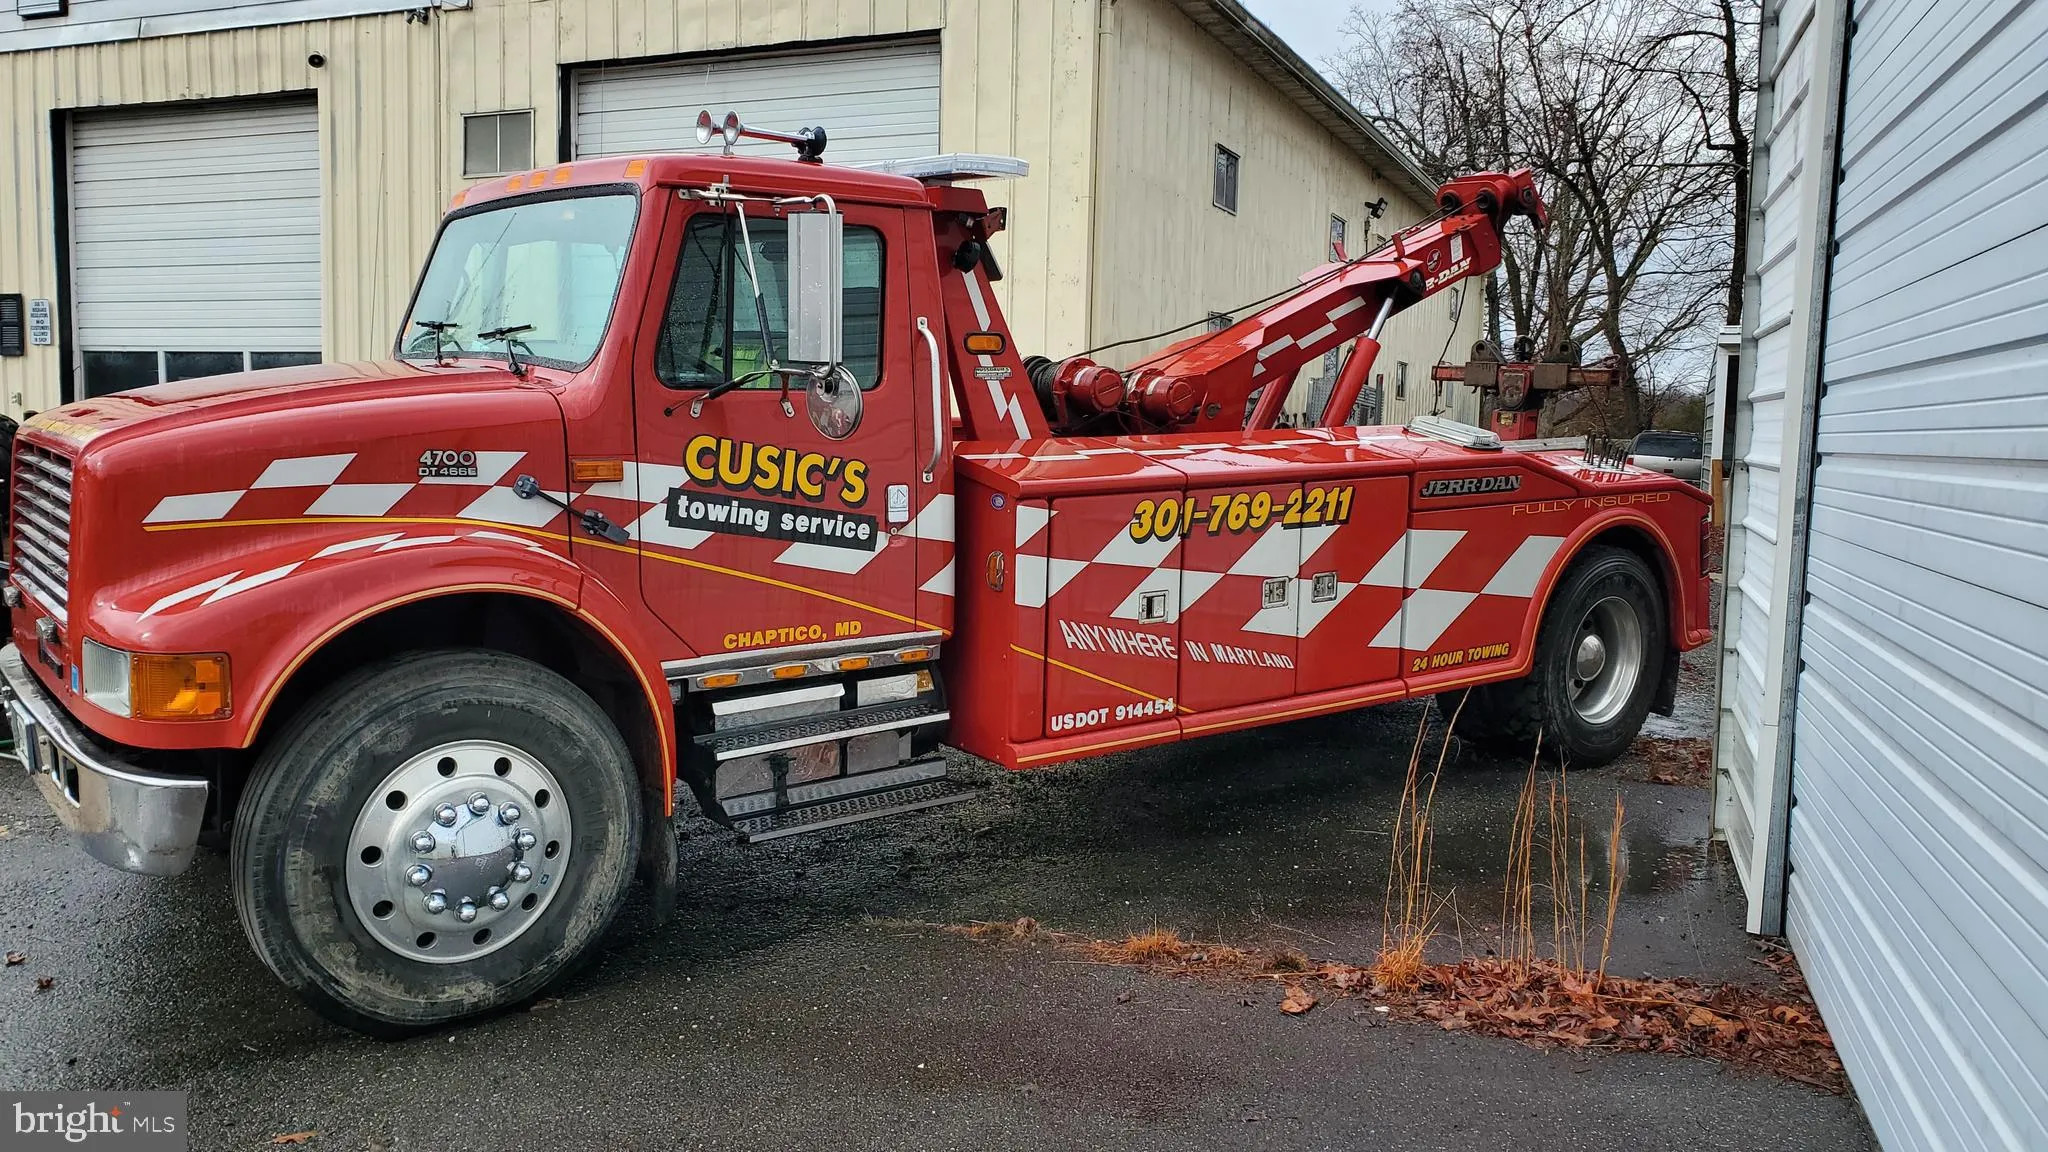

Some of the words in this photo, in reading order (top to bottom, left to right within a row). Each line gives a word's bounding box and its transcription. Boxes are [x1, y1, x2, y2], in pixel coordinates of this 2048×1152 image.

[1425, 257, 1472, 291] R-DAN
[418, 467, 437, 476] DT
[439, 467, 477, 476] 466E
[419, 449, 475, 466] 4700
[684, 434, 868, 506] CUSIC'S
[677, 494, 770, 532] towing
[780, 511, 871, 541] service
[1130, 486, 1355, 543] 301-769-2211
[1512, 499, 1577, 516] FULLY
[1583, 491, 1672, 509] INSURED
[723, 624, 828, 650] CHAPTICO,
[834, 620, 863, 637] MD
[1058, 619, 1178, 660] ANYWHERE
[1184, 640, 1210, 664] IN
[1209, 642, 1295, 670] MARYLAND
[1411, 656, 1429, 672] 24
[1431, 650, 1464, 668] HOUR
[1467, 642, 1511, 662] TOWING
[1051, 707, 1110, 732] USDOT
[1115, 697, 1175, 721] 914454
